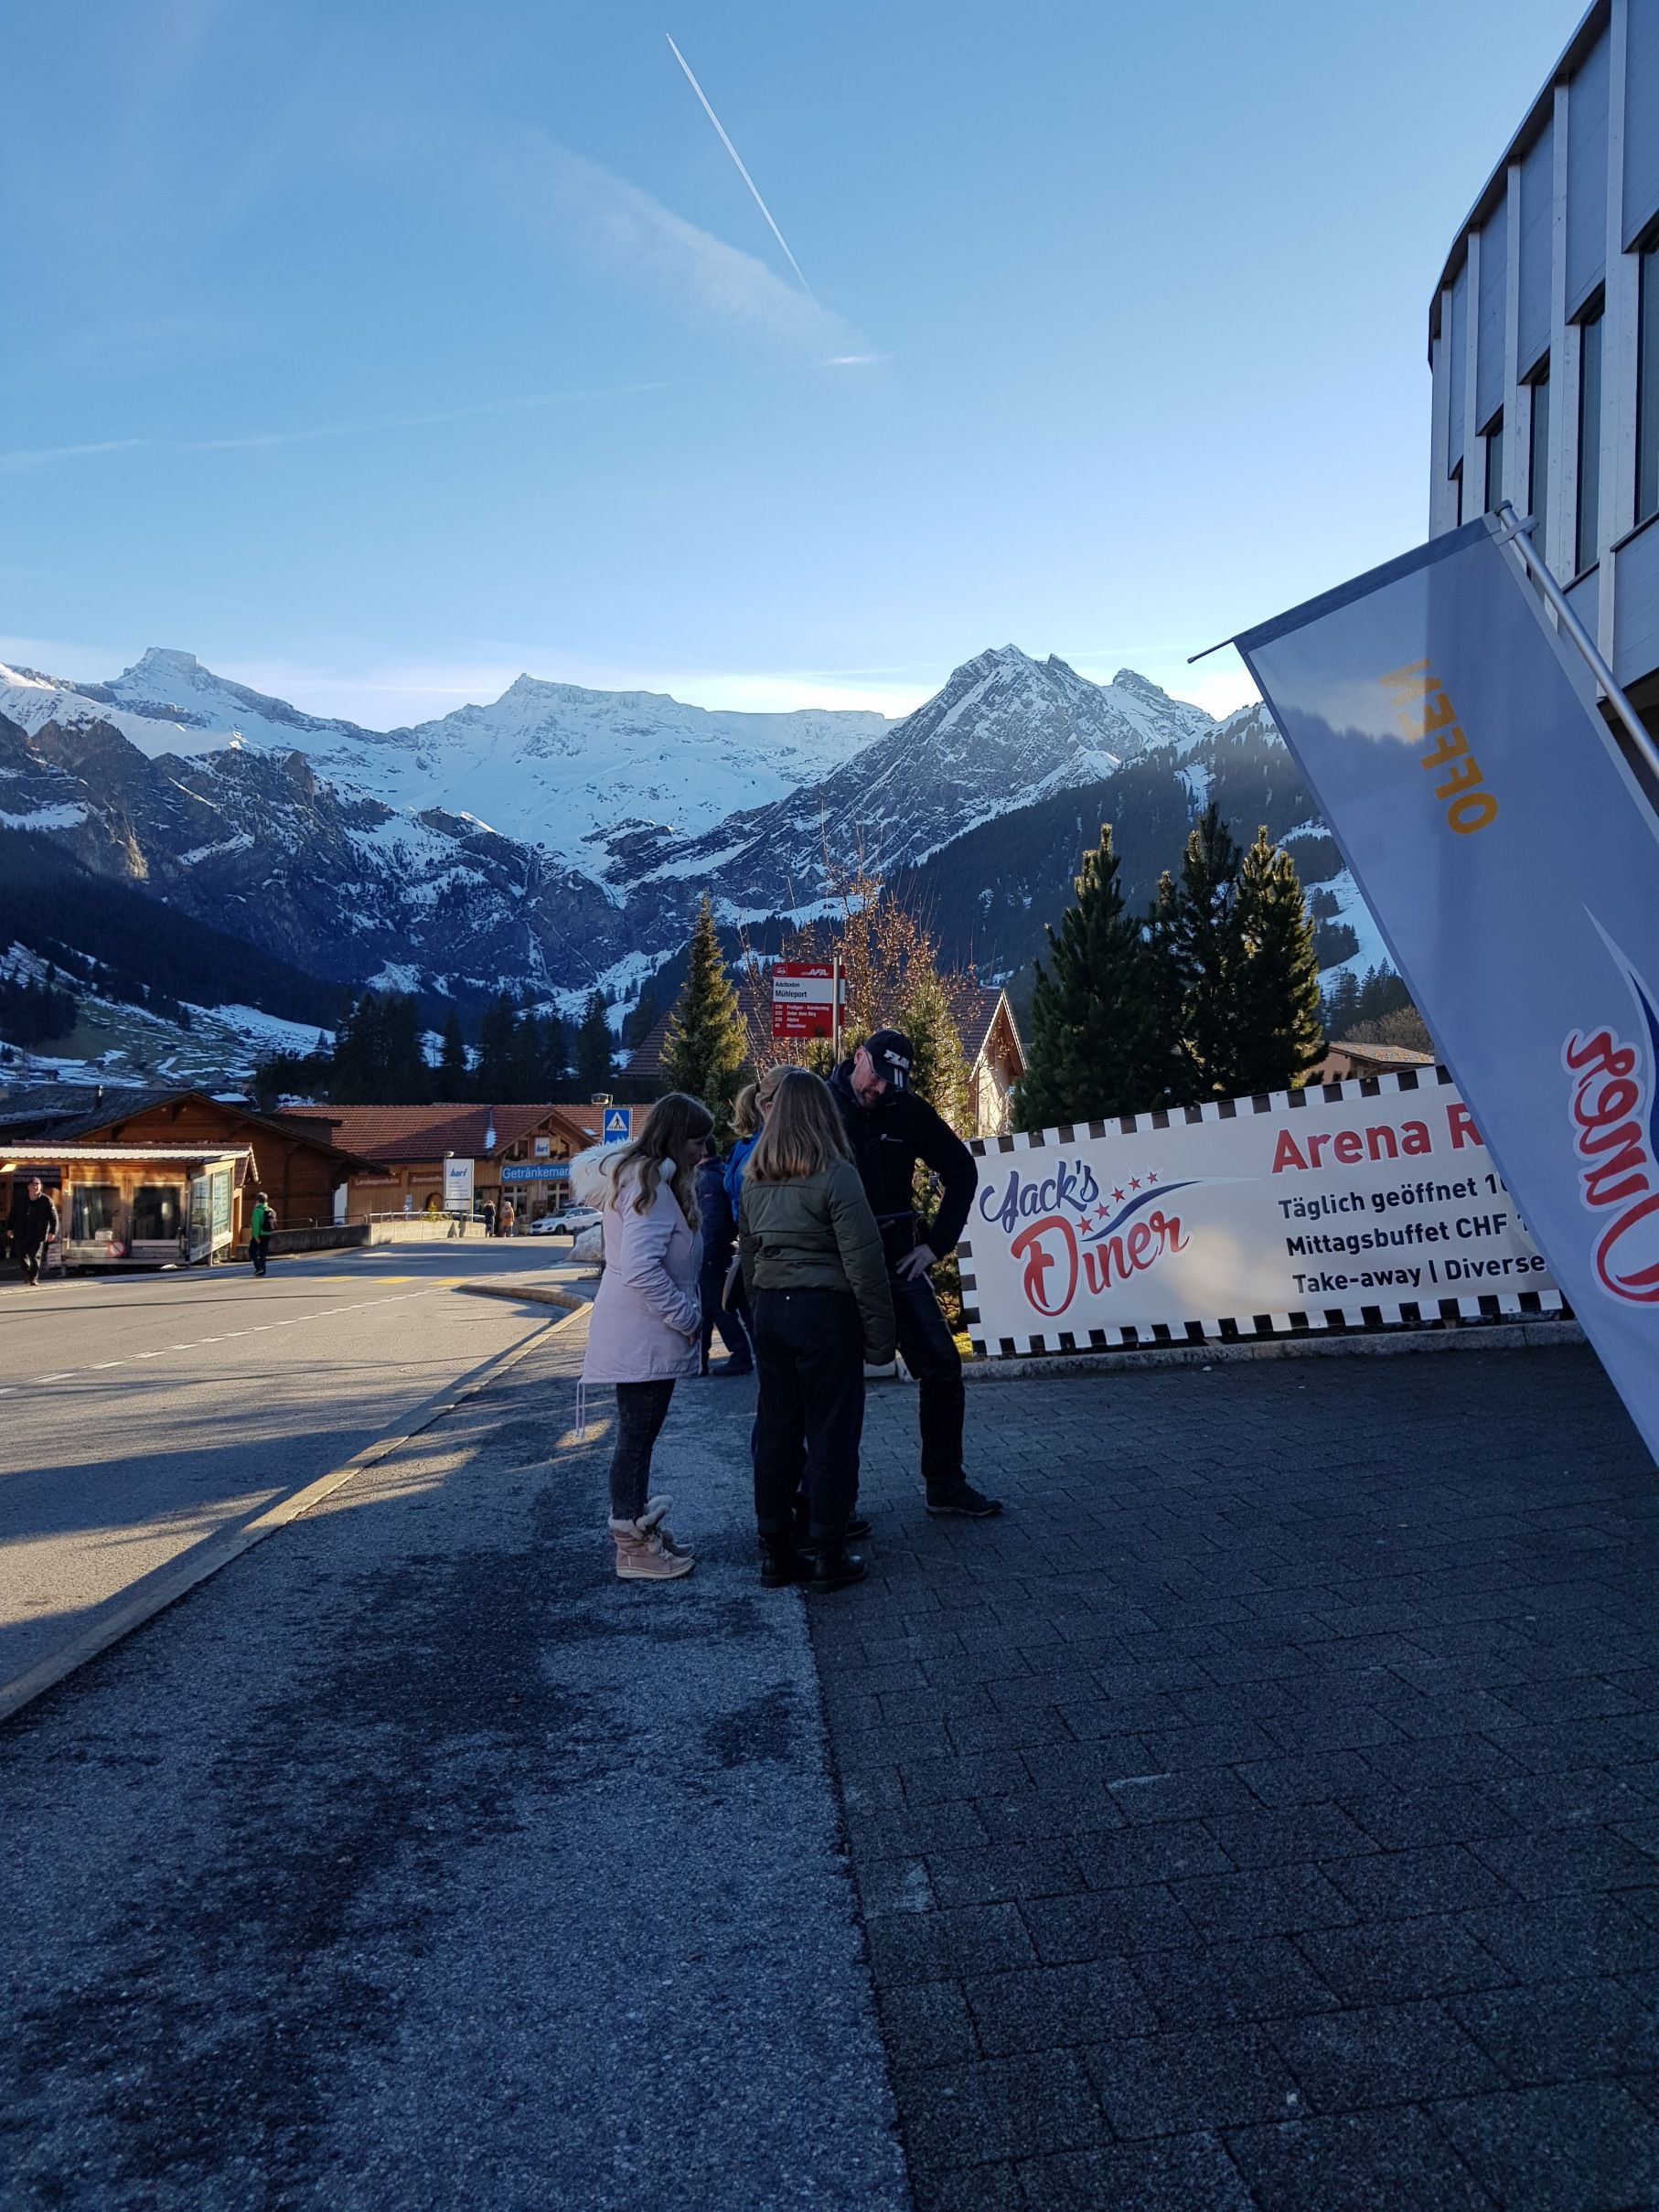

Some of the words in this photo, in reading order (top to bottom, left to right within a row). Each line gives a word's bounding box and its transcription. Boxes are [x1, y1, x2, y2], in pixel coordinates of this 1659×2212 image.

[808, 968, 827, 977] AFA
[775, 990, 808, 999] Mühleport
[1272, 1120, 1432, 1173] Arena
[1445, 1103, 1485, 1149] R
[502, 1166, 571, 1179] Getränkemar
[979, 1159, 1098, 1233] Jack's
[1278, 1191, 1365, 1220] Täglich
[1371, 1178, 1478, 1213] geöffnet
[1286, 1221, 1450, 1256] Mittagsbuffet
[1455, 1213, 1507, 1238] CHF
[1011, 1211, 1190, 1317] Diner
[1292, 1267, 1421, 1294] Take-away
[1444, 1254, 1546, 1281] Diverse
